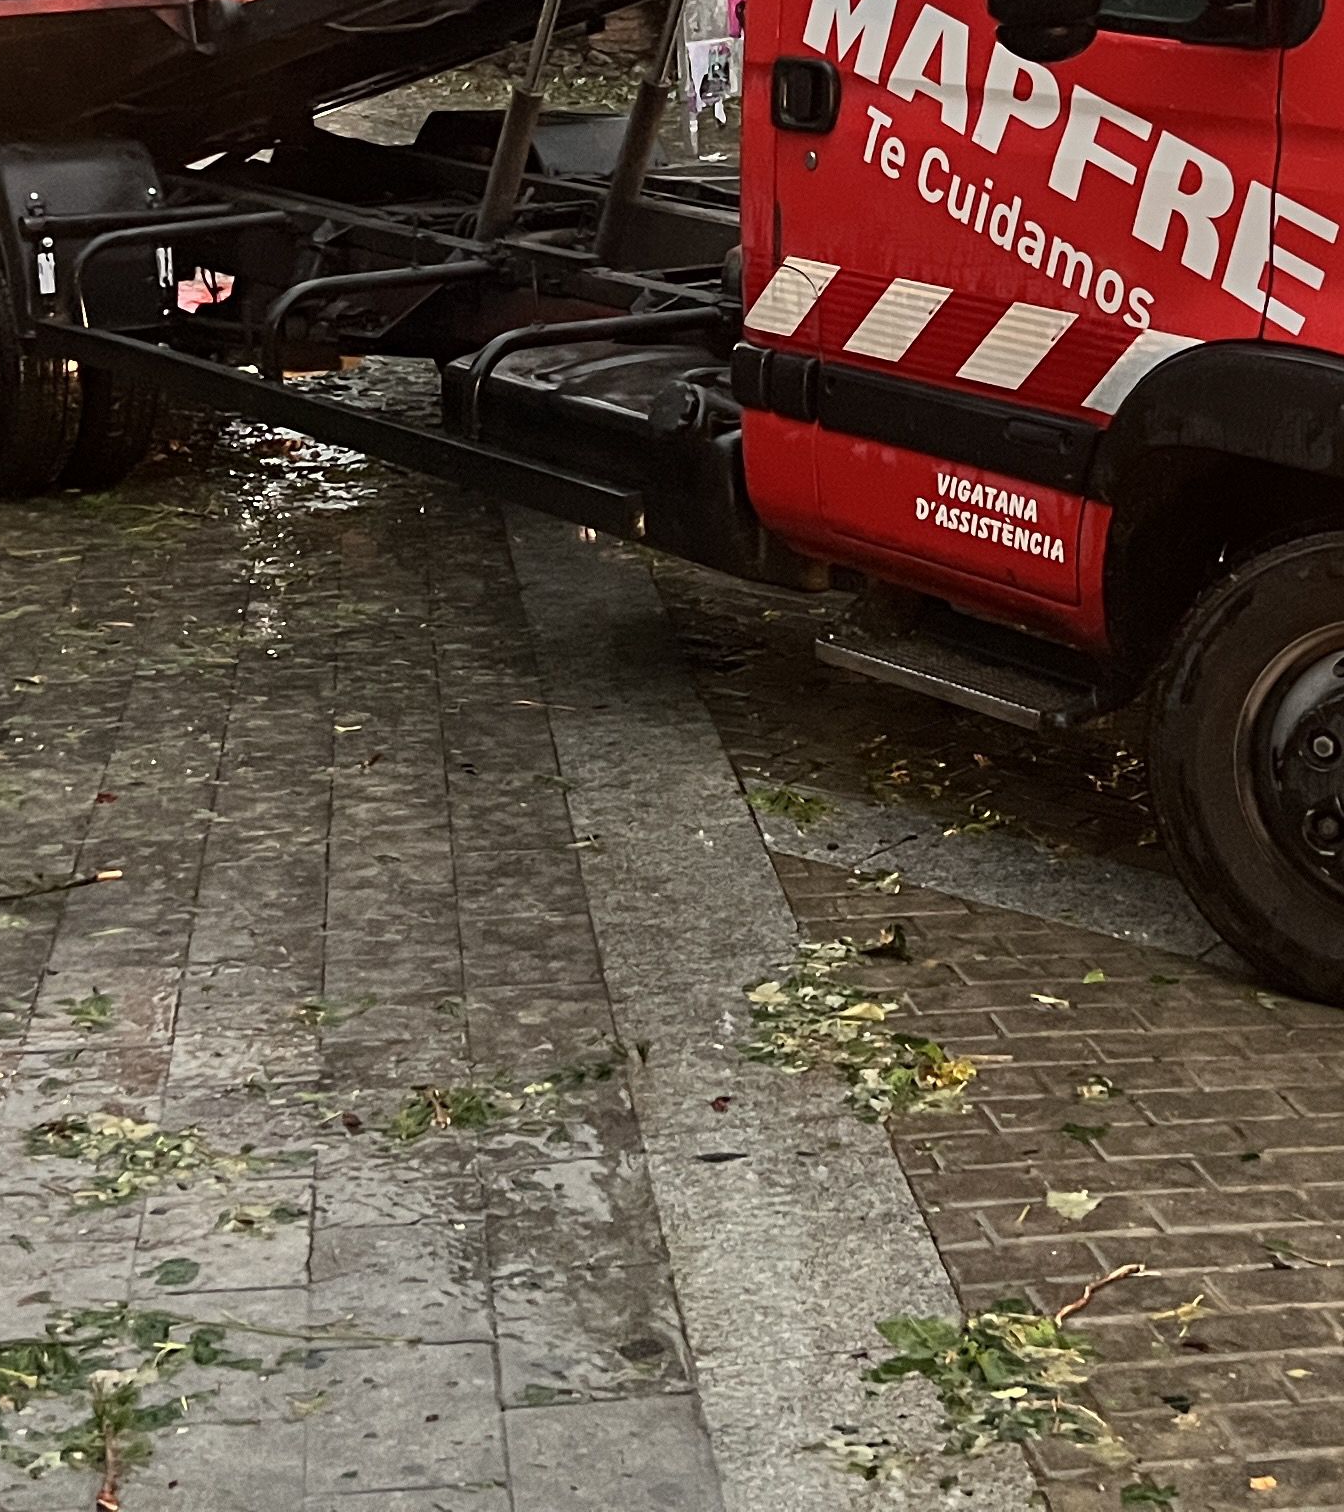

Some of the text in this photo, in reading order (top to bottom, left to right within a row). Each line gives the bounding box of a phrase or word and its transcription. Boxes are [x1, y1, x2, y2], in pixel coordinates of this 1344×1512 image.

[863, 106, 1156, 332] Te Cuidamos
[916, 497, 1064, 563] D'ASSISTÈNCIA
[937, 472, 1038, 523] VIGATANA
